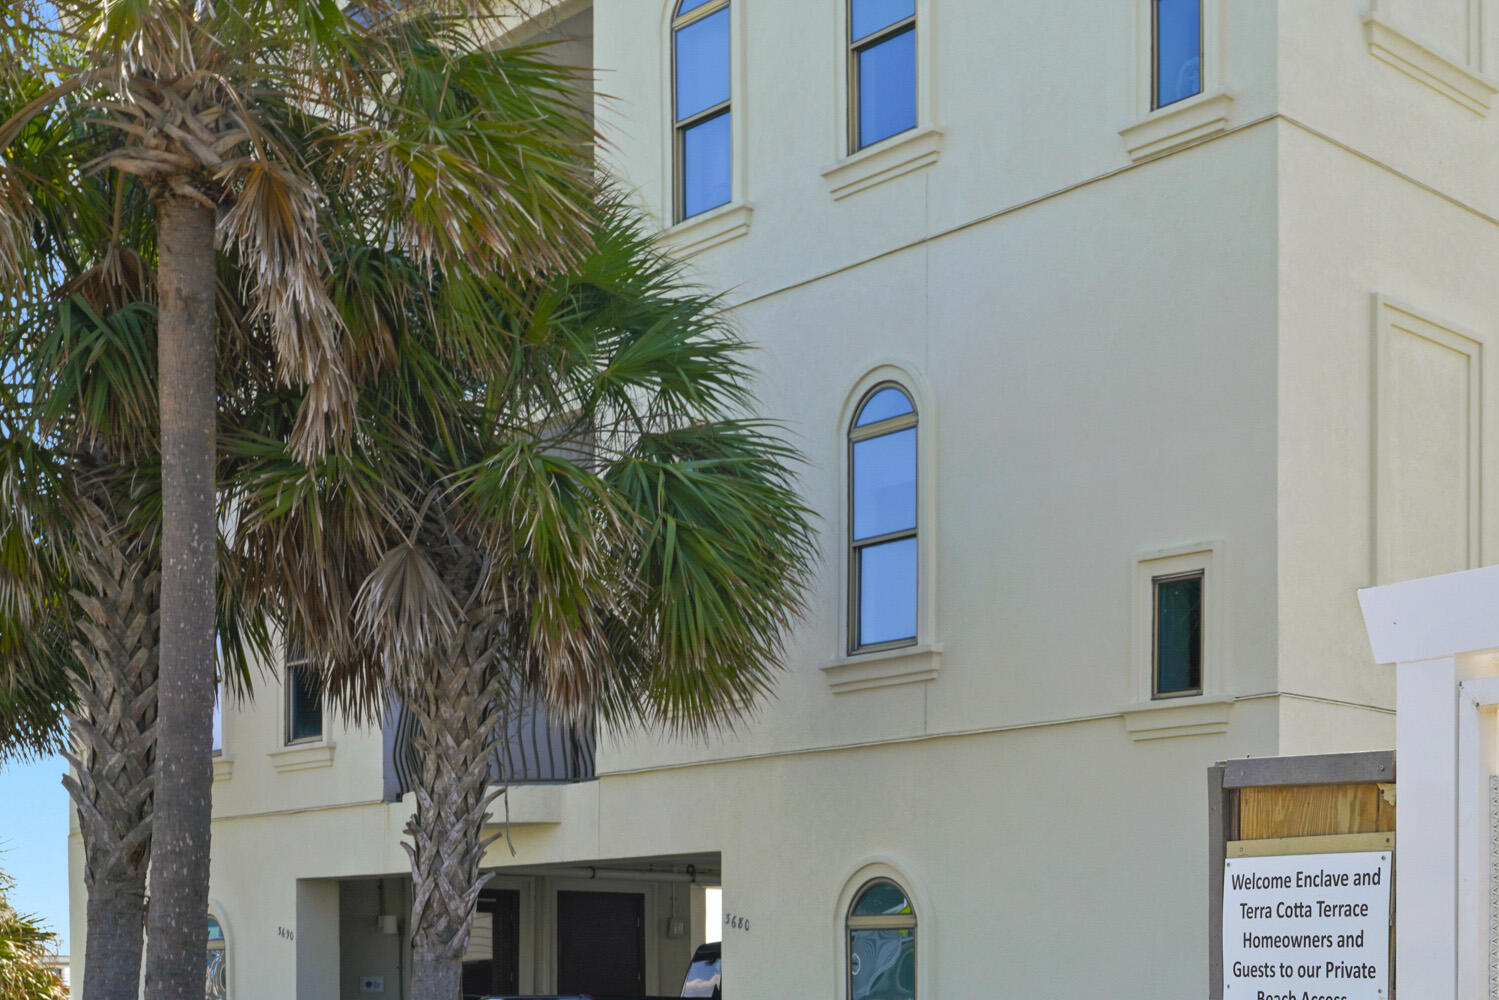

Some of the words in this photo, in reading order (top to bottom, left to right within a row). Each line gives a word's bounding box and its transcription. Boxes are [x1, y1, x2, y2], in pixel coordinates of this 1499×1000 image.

[1231, 873, 1292, 890] Welcome
[1296, 869, 1349, 888] Enclave
[1353, 867, 1381, 886] and
[1240, 902, 1272, 919] Terra
[1276, 901, 1312, 918] Cotta
[1316, 900, 1369, 918] Terrace
[1242, 932, 1333, 949] Homeowners
[1337, 930, 1364, 948] and
[1232, 961, 1276, 978] Guests
[1279, 963, 1293, 978] to
[1297, 964, 1322, 978] our
[1325, 961, 1377, 979] Private
